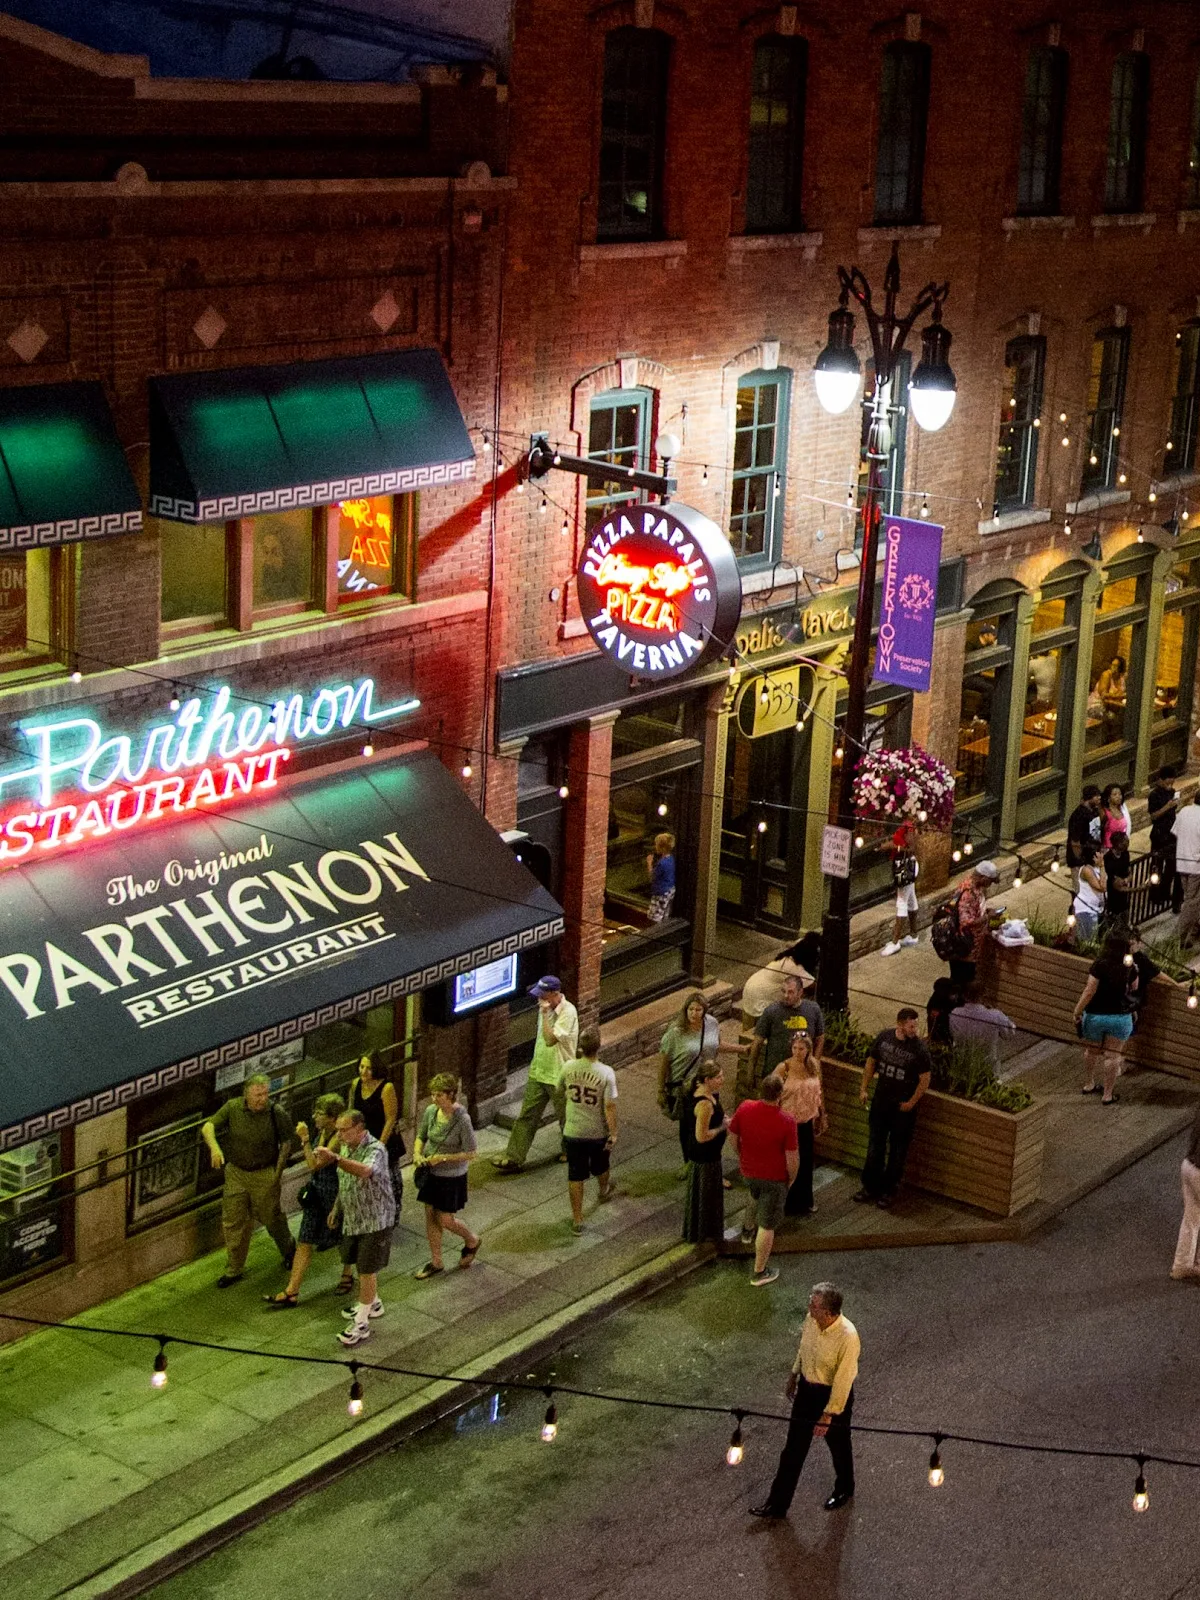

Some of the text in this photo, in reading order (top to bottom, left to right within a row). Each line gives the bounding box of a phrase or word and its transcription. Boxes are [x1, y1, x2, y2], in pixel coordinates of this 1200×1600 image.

[583, 515, 635, 579] PIZZA
[643, 512, 711, 602] PAPALIS
[607, 587, 677, 633] PIZZA
[879, 525, 901, 674] GREEKTOWN
[590, 608, 700, 671] TAVERNA
[899, 662, 923, 675] Society
[0, 678, 420, 807] Parthenon
[0, 748, 291, 857] STAURANT
[106, 834, 275, 906] The Original
[827, 840, 845, 852] ZONE
[833, 852, 846, 862] MIN
[0, 832, 432, 1020] PARTHENON
[125, 916, 386, 1025] RESTAURANT
[568, 1084, 598, 1106] 35
[12, 1224, 58, 1249] ACCEPTED
